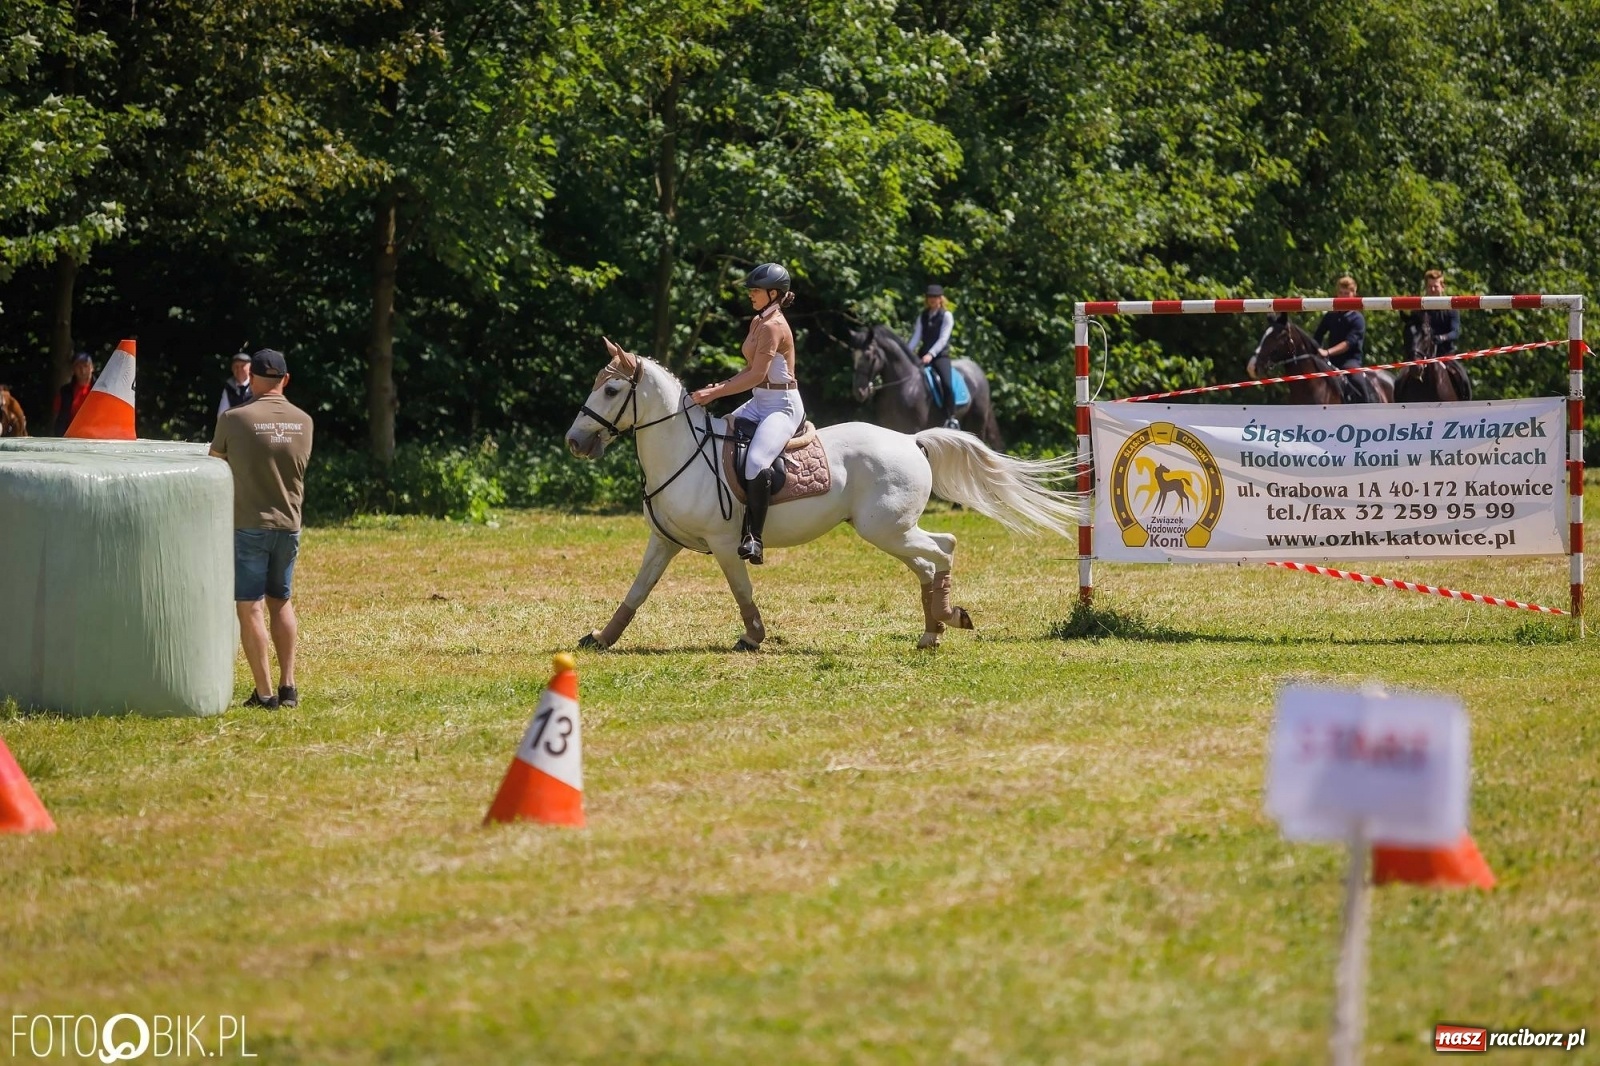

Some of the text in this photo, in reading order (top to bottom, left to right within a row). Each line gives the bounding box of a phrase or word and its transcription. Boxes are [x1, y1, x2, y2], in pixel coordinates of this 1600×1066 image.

[1241, 416, 1547, 448] Śląsko-Opolski Związek
[1182, 435, 1209, 463] OPOLSKI
[1240, 447, 1547, 468] Hodowców Koni w Katowicach
[1237, 478, 1554, 498] ul. Grabowa 1A 40-172 Katowice
[1151, 516, 1184, 526] Związek
[1266, 502, 1516, 522] tel./fax 32 259 95 99
[1146, 524, 1188, 534] Hodowców
[1149, 533, 1184, 548] Koni
[1266, 529, 1516, 550] www.ozhk-katowice.pl
[530, 707, 573, 757] 13
